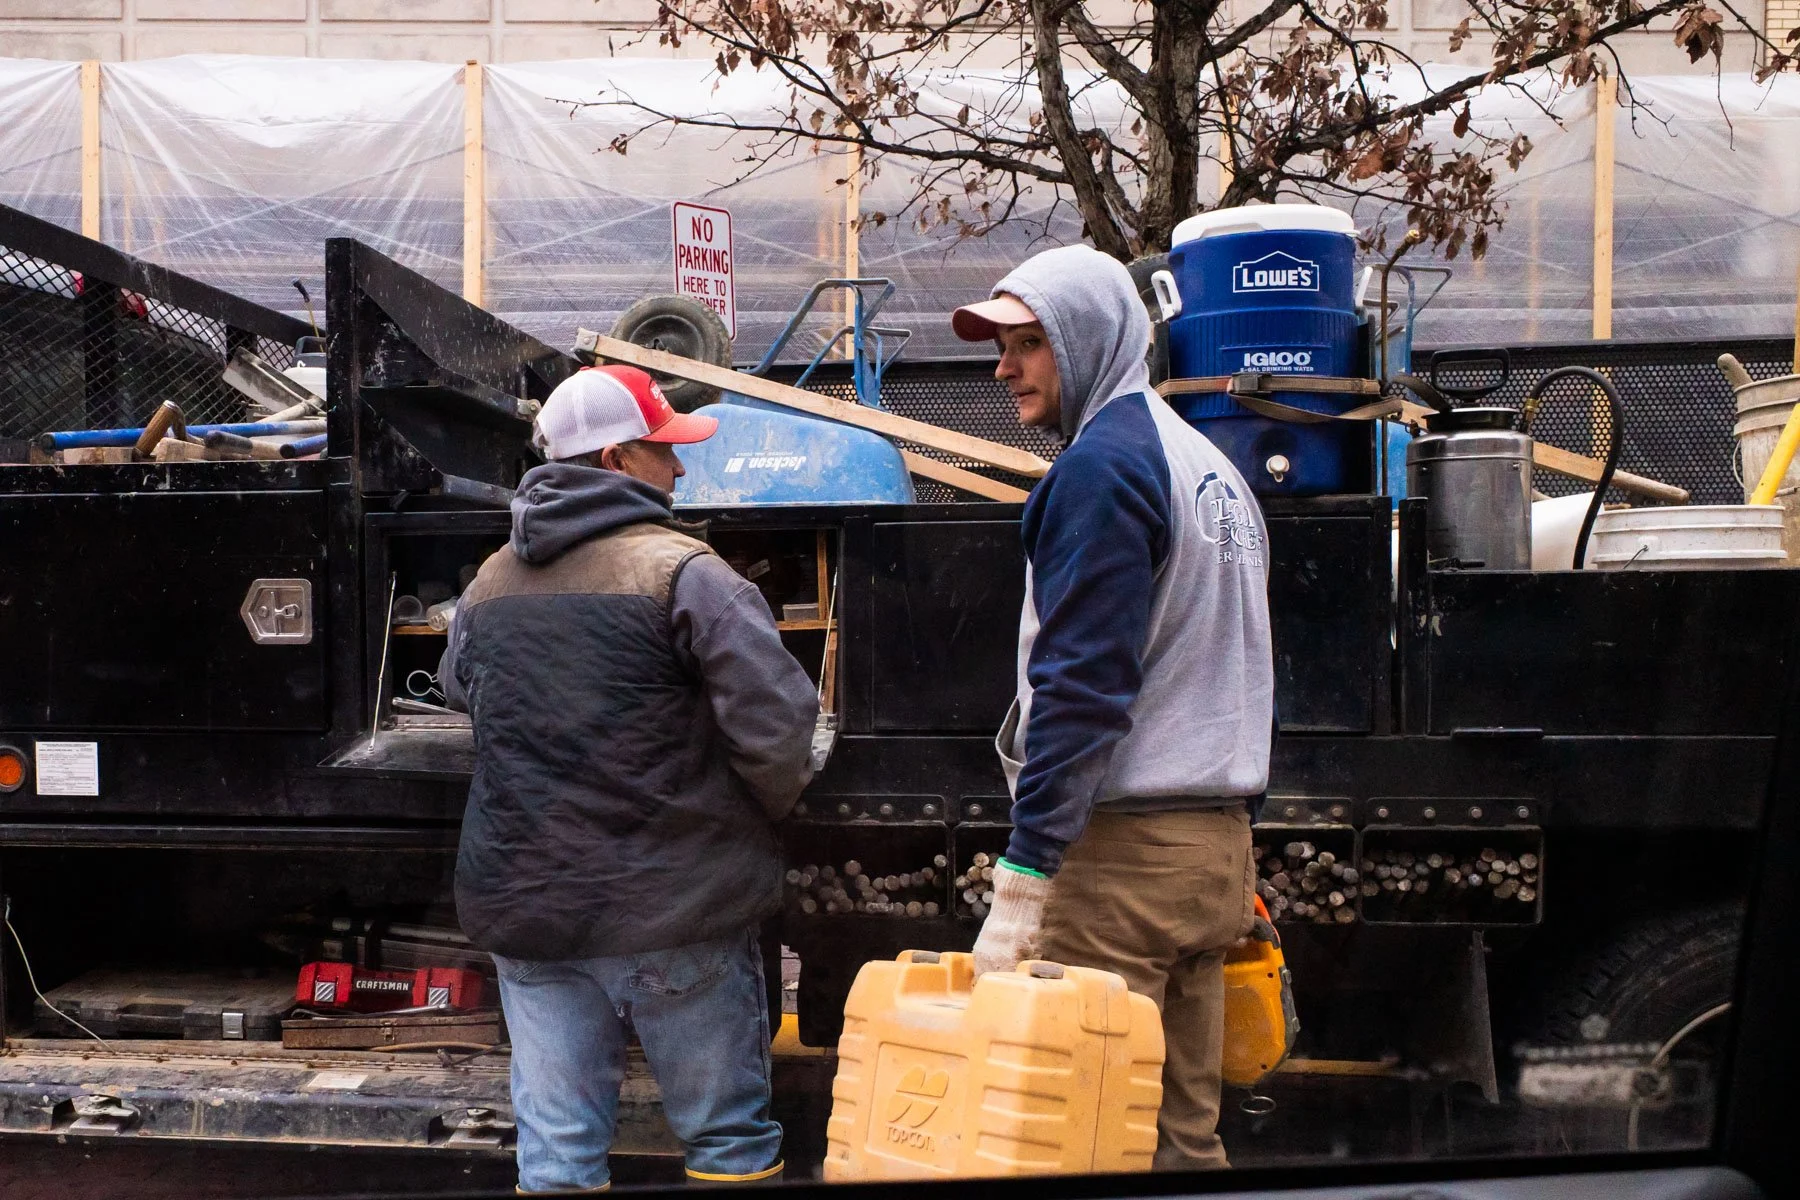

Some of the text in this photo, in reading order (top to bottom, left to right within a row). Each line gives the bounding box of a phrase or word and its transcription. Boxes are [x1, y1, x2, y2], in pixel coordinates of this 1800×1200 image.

[691, 216, 713, 243] NO
[678, 244, 729, 275] PARKING
[683, 275, 727, 297] HERE TO
[1242, 267, 1313, 288] LOWE'S
[1243, 352, 1311, 367] IGLOO
[748, 456, 807, 472] Jackson
[355, 980, 409, 991] CRAFTSMAN
[886, 1126, 936, 1153] TOPCON
